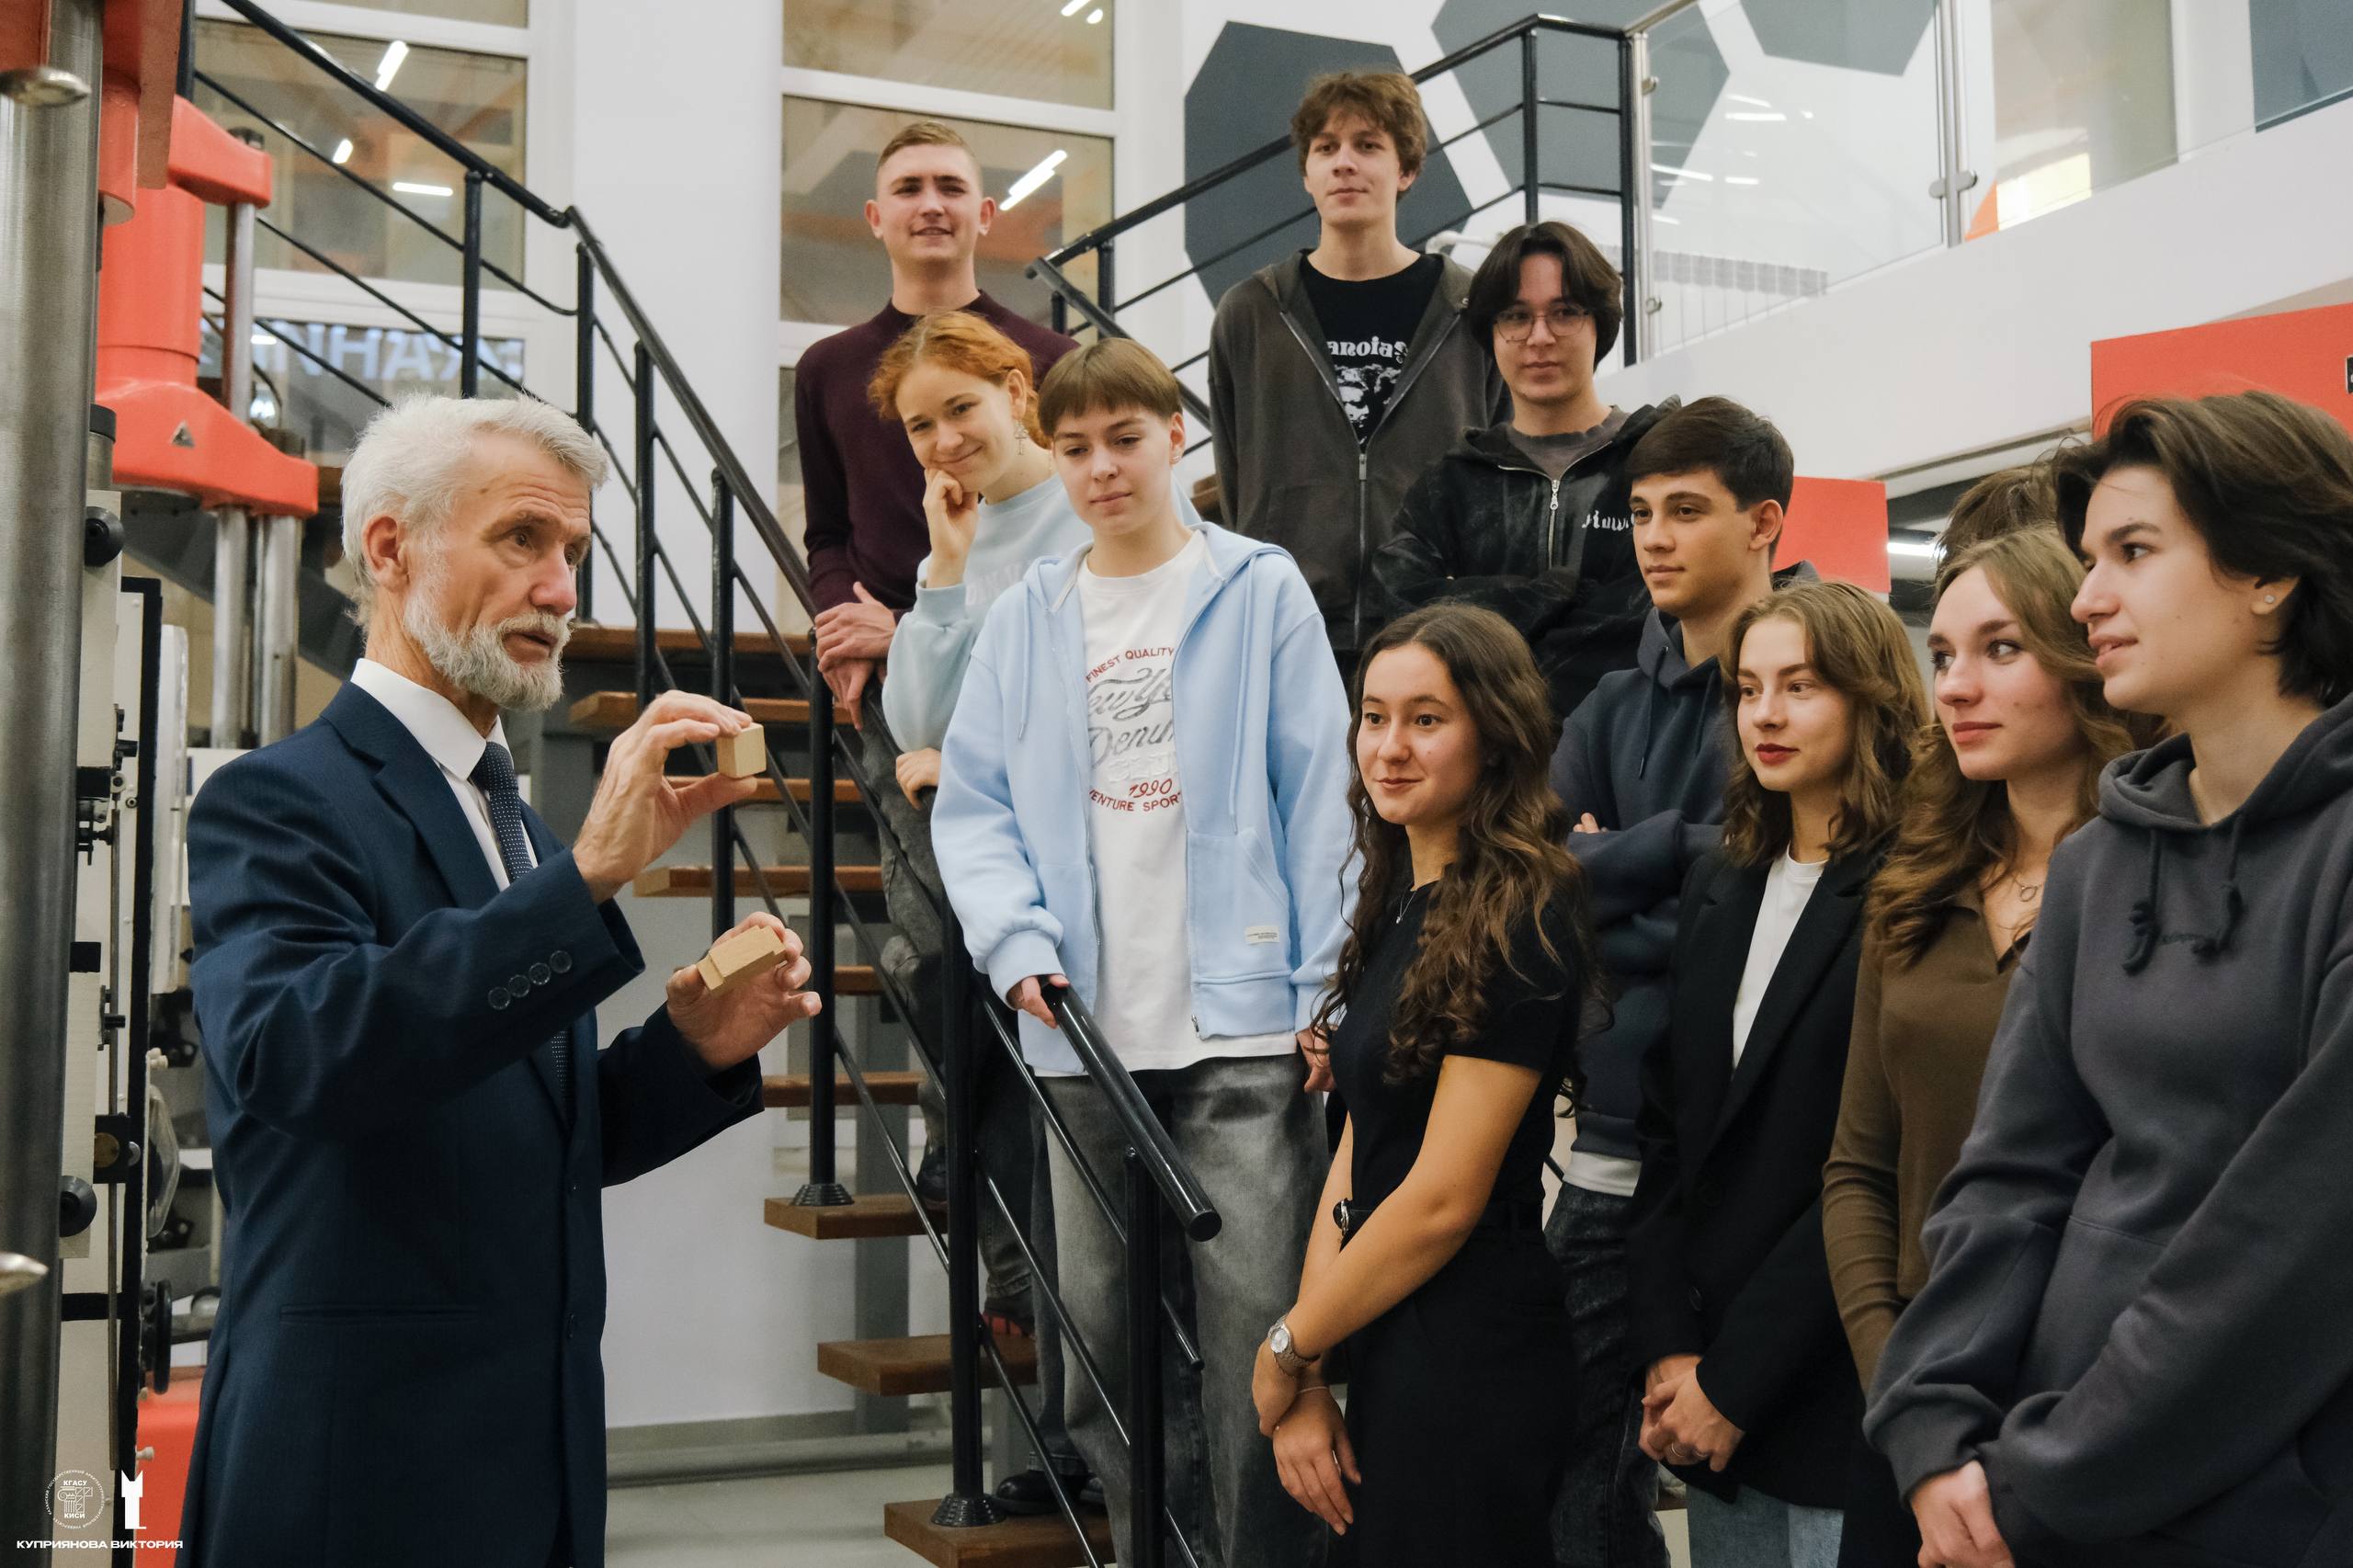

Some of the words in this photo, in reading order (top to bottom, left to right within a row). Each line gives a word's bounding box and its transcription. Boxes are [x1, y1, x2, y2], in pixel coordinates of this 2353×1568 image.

[1086, 655, 1120, 683] FINEST
[1125, 647, 1174, 660] QUALITY
[1129, 778, 1172, 799] 1990
[1142, 791, 1181, 812] SPOR
